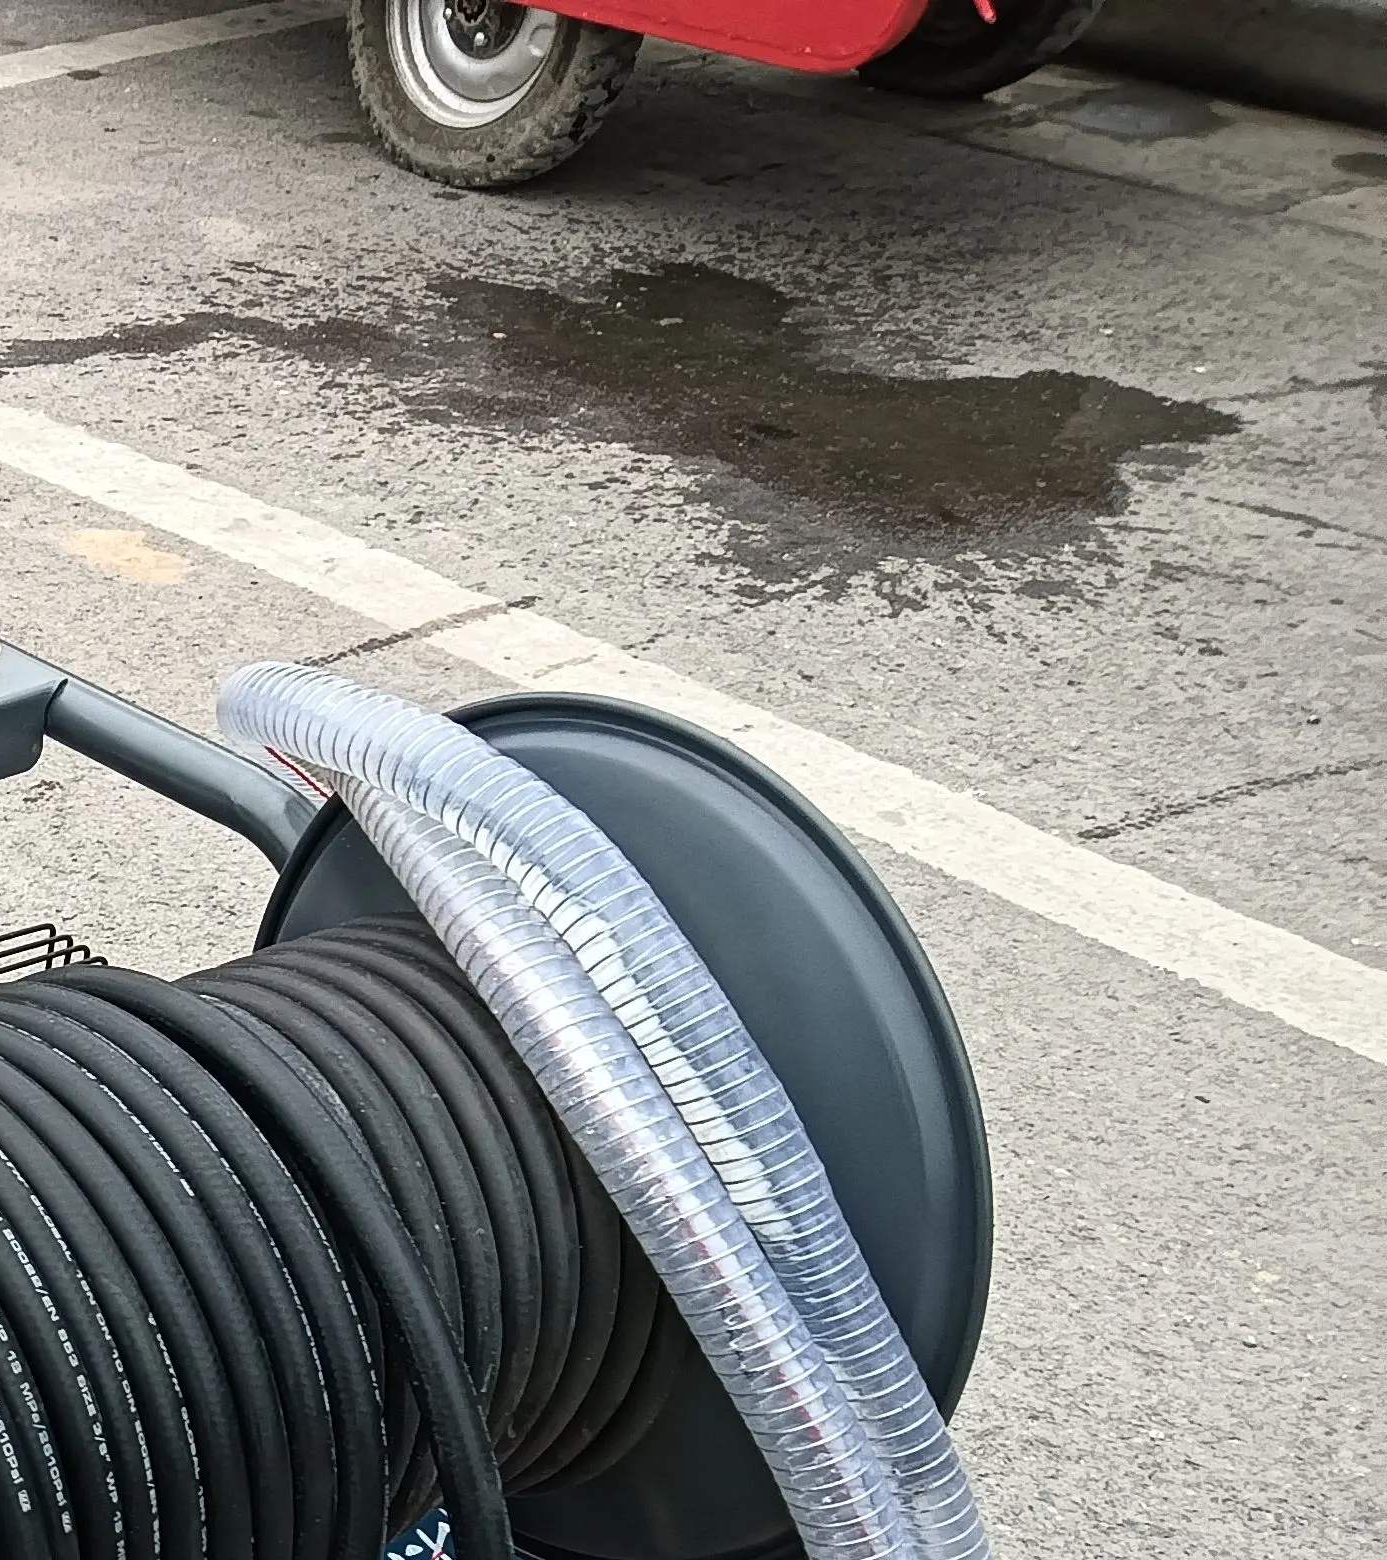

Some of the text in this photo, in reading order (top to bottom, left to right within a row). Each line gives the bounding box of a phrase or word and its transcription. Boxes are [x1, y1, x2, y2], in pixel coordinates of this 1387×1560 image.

[2, 1228, 60, 1322] 20022/EN
[106, 1471, 118, 1503] WP
[30, 1194, 73, 1262] GLOBAL
[96, 1312, 112, 1341] DN
